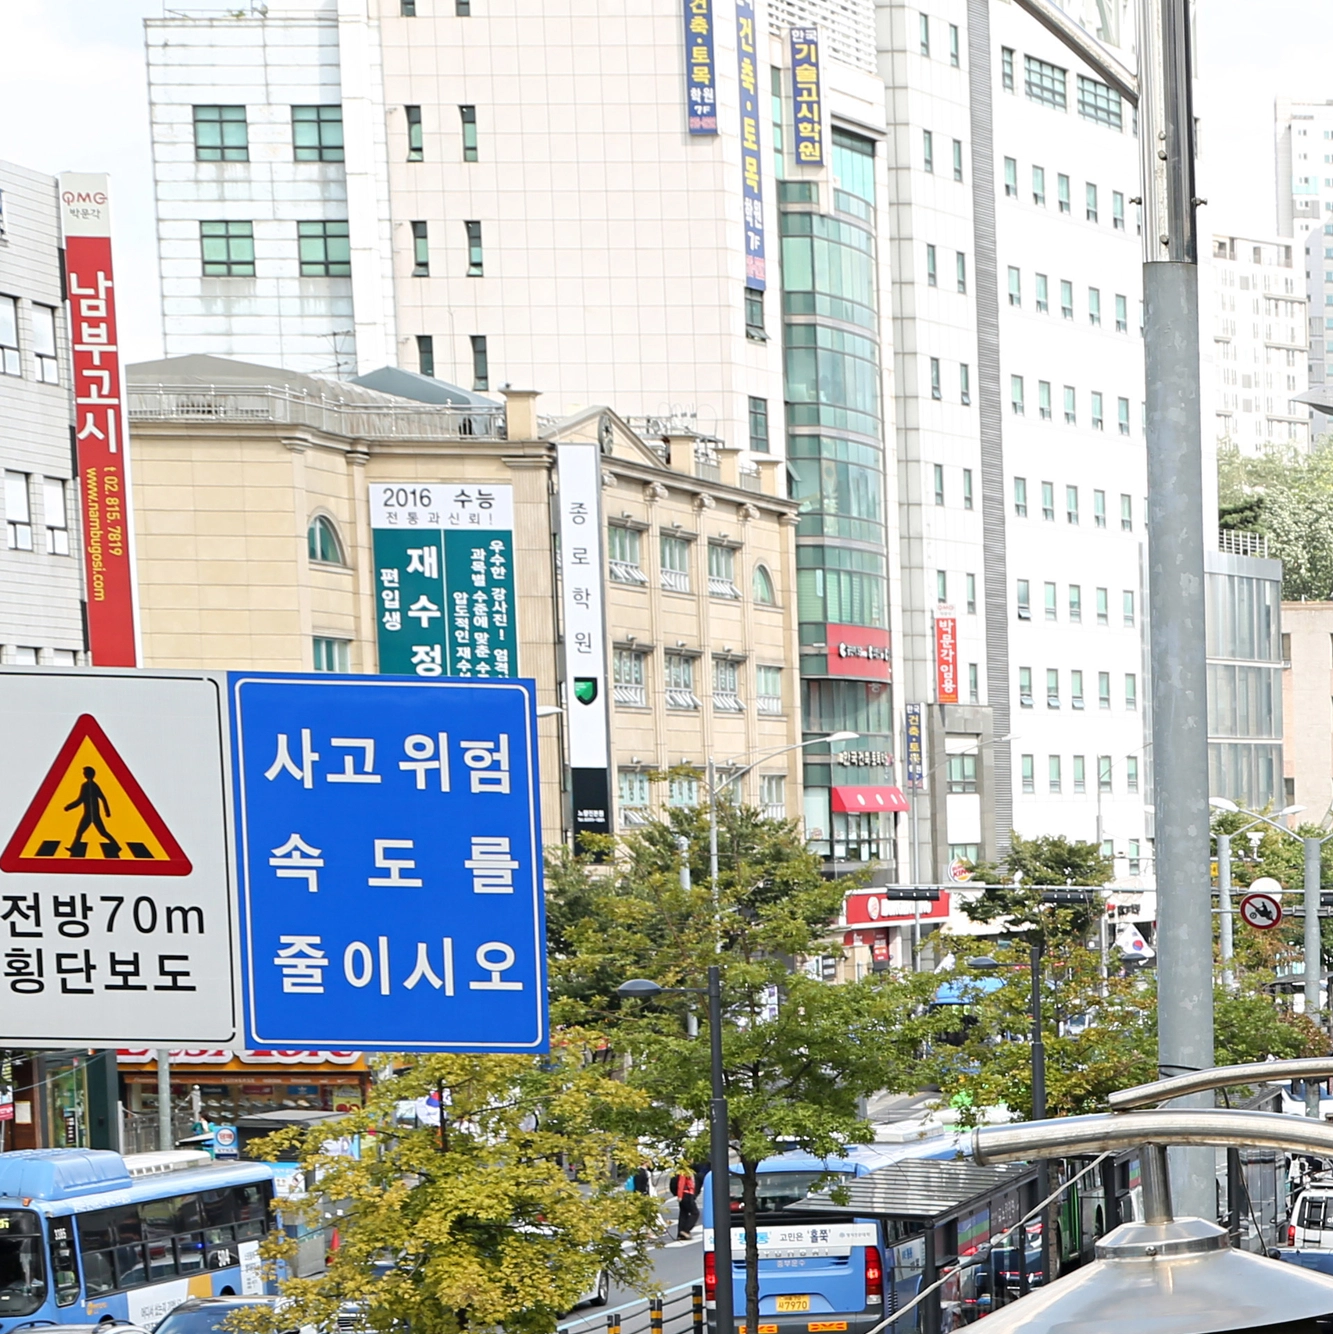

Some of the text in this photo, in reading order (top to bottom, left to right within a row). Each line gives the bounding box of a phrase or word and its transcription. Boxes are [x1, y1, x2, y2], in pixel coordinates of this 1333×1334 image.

[791, 28, 817, 42] 한국
[690, 87, 714, 103] 학원
[694, 105, 711, 114] 7F
[794, 44, 821, 162] 기술고시학원
[69, 207, 102, 220] 박문각
[744, 197, 763, 229] 학원
[70, 270, 119, 454] 남부고시
[383, 488, 496, 509] 2016 수능
[86, 467, 106, 601] www.nambugosi.com
[380, 567, 402, 631] 편입생
[488, 540, 509, 641] 우수한 강사진!
[568, 502, 592, 655] 종로학원
[263, 728, 511, 794] 사고 위험
[268, 832, 520, 893] 속도를
[3, 946, 198, 995] 횡단보도
[273, 935, 524, 997] 줄이시오
